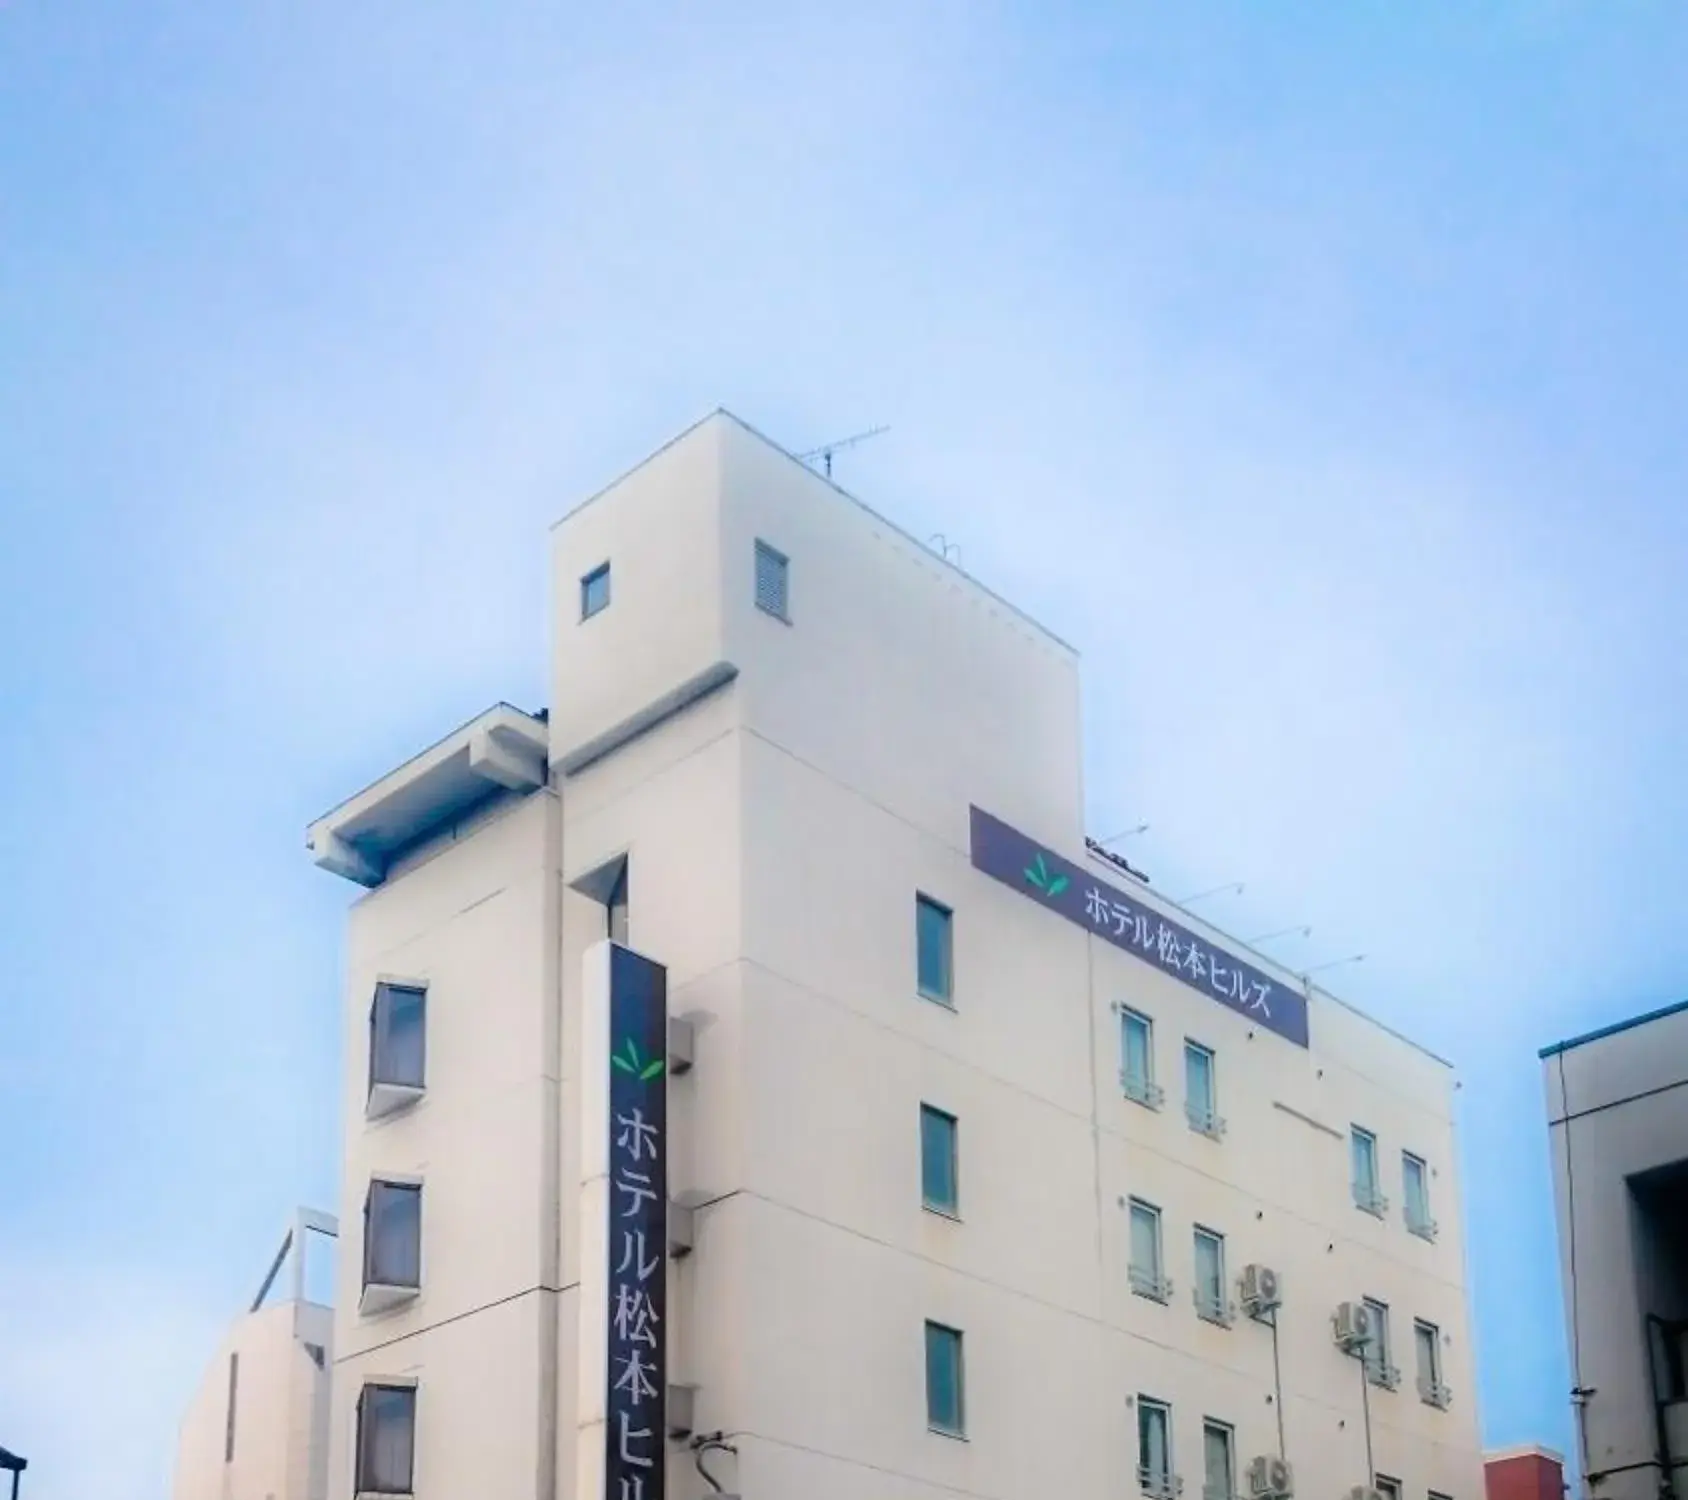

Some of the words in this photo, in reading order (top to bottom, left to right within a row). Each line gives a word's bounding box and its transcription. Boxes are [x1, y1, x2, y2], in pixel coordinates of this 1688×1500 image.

[1085, 886, 1272, 1017] ホテル松本ヒルズ
